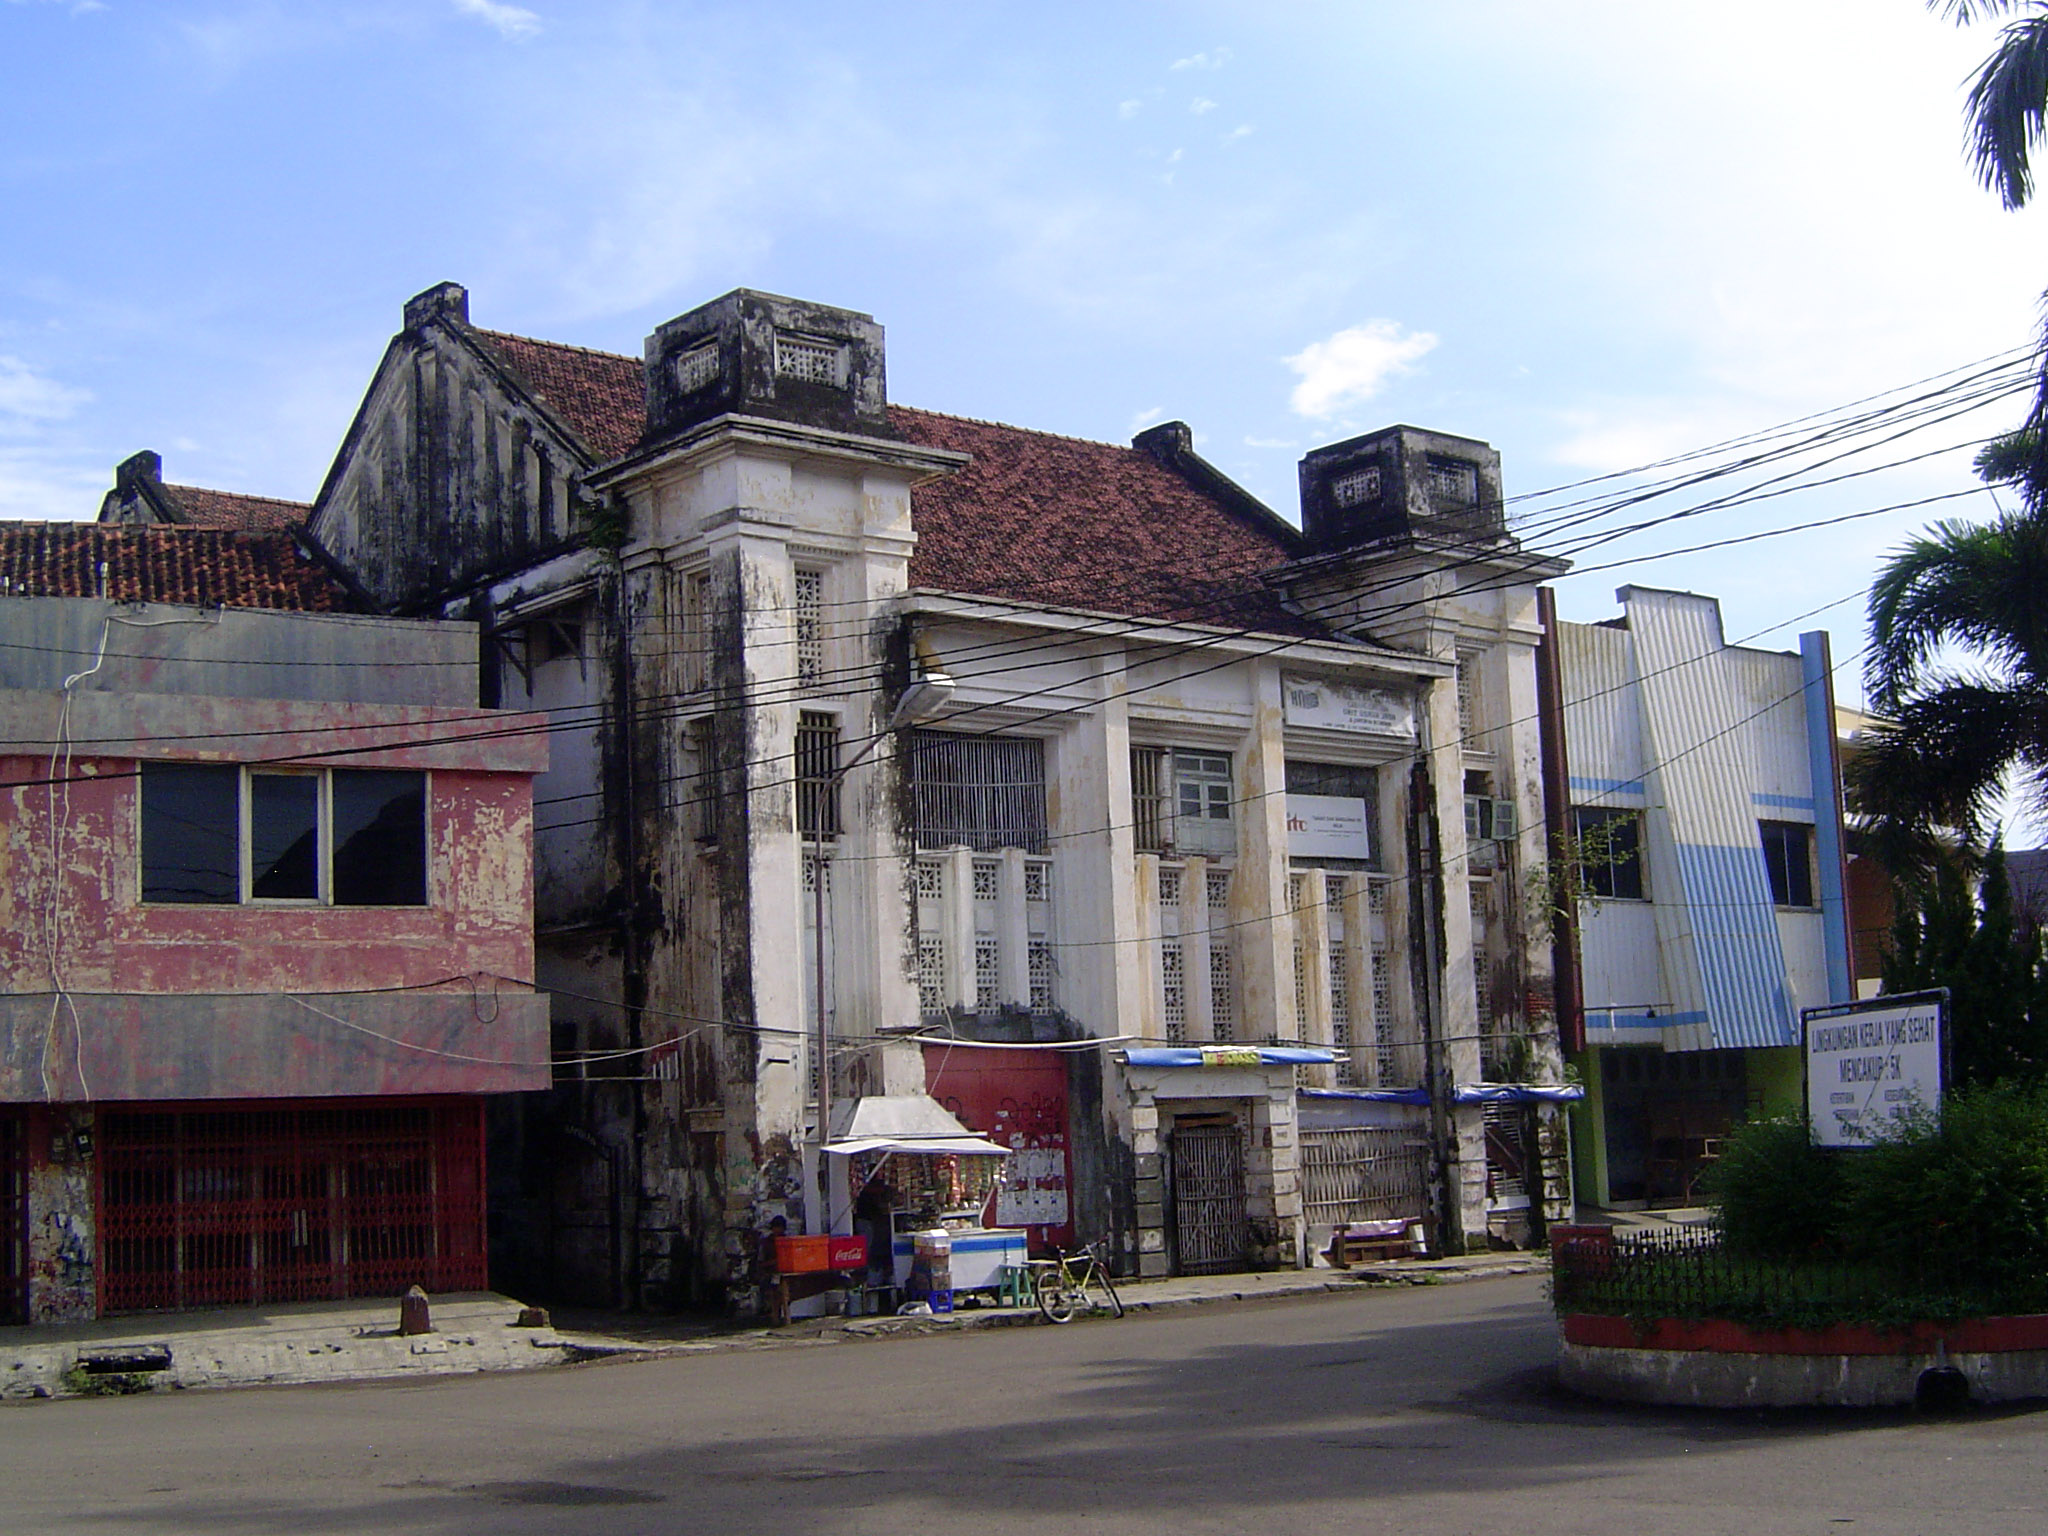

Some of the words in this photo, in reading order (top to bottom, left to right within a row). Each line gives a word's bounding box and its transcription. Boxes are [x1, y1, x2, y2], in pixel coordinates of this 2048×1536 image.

[1812, 1024, 1858, 1053] LINGKUNGAN
[1860, 1021, 1883, 1047] KERJA
[1884, 1018, 1906, 1045] YANG
[1908, 1016, 1935, 1043] SEHAT
[1840, 1056, 1883, 1082] MENCAKUP
[835, 1247, 864, 1262] Coca-Cola
